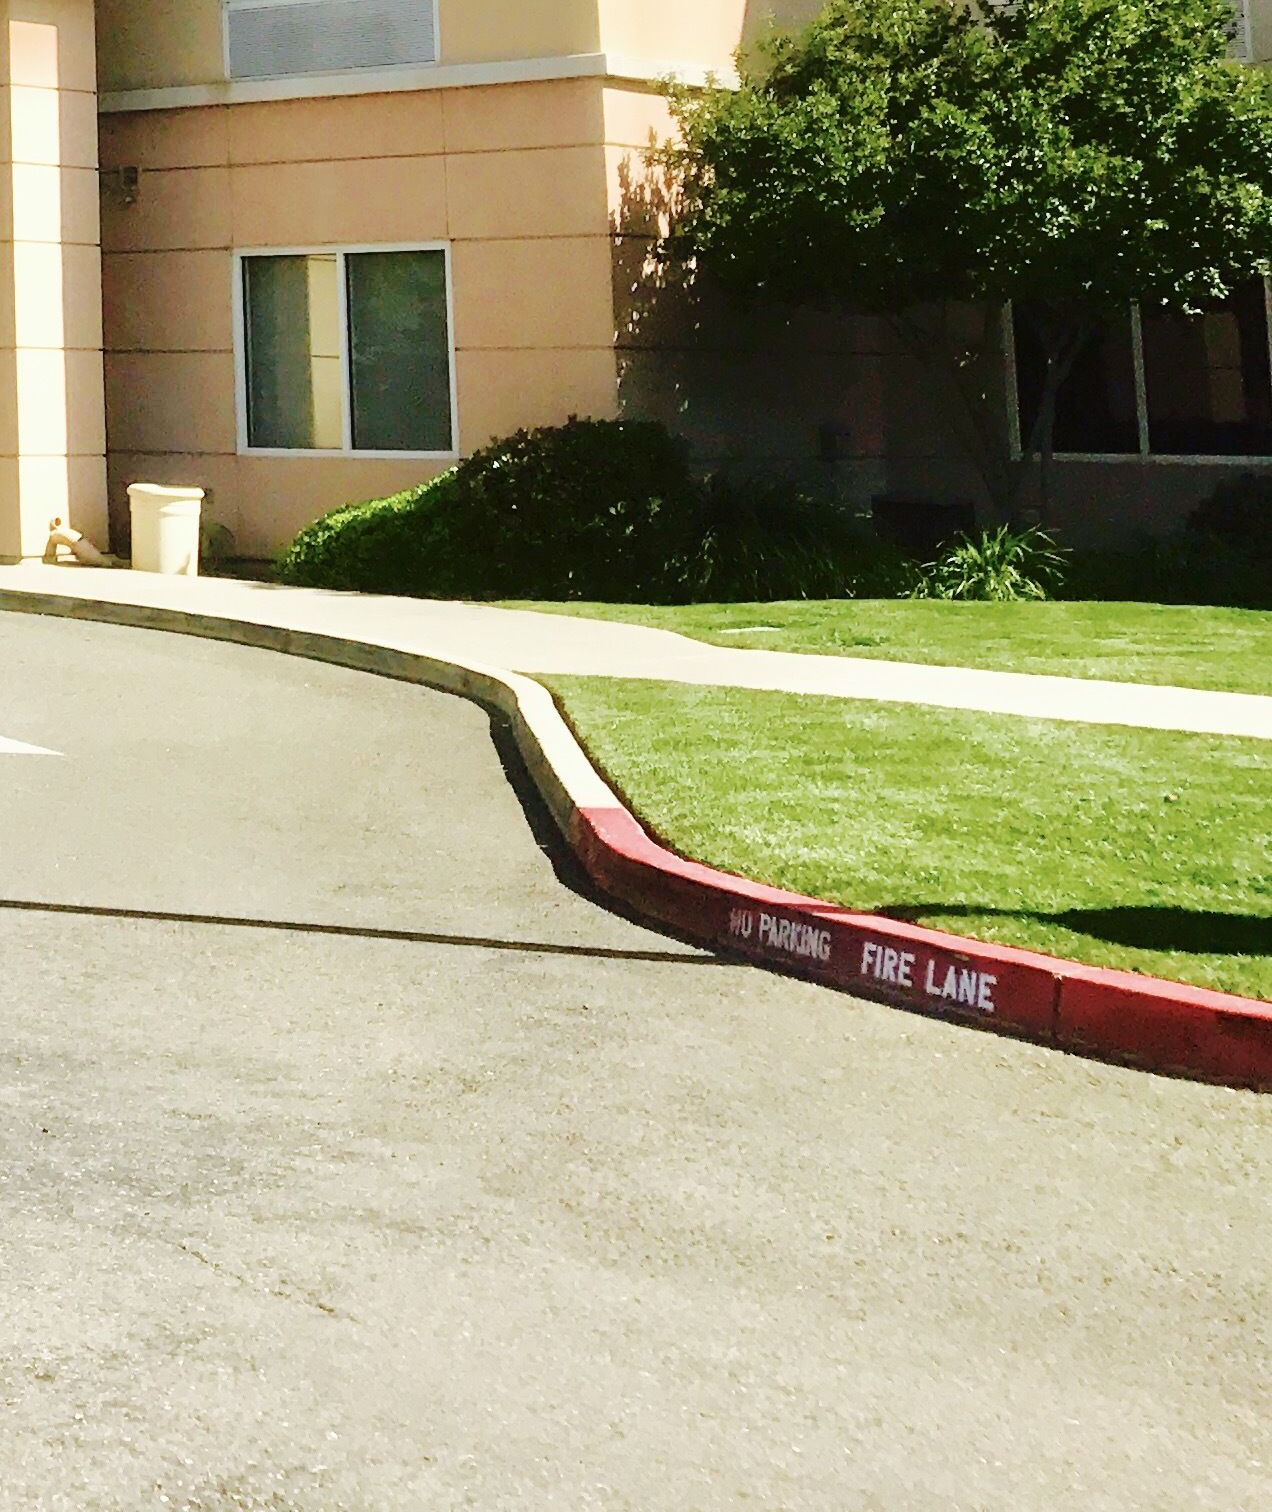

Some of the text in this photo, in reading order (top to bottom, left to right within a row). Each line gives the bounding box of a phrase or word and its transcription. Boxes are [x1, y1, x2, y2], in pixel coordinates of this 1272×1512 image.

[759, 913, 831, 961] PARKING
[860, 941, 916, 988] FIRE
[925, 959, 998, 1013] LANE
